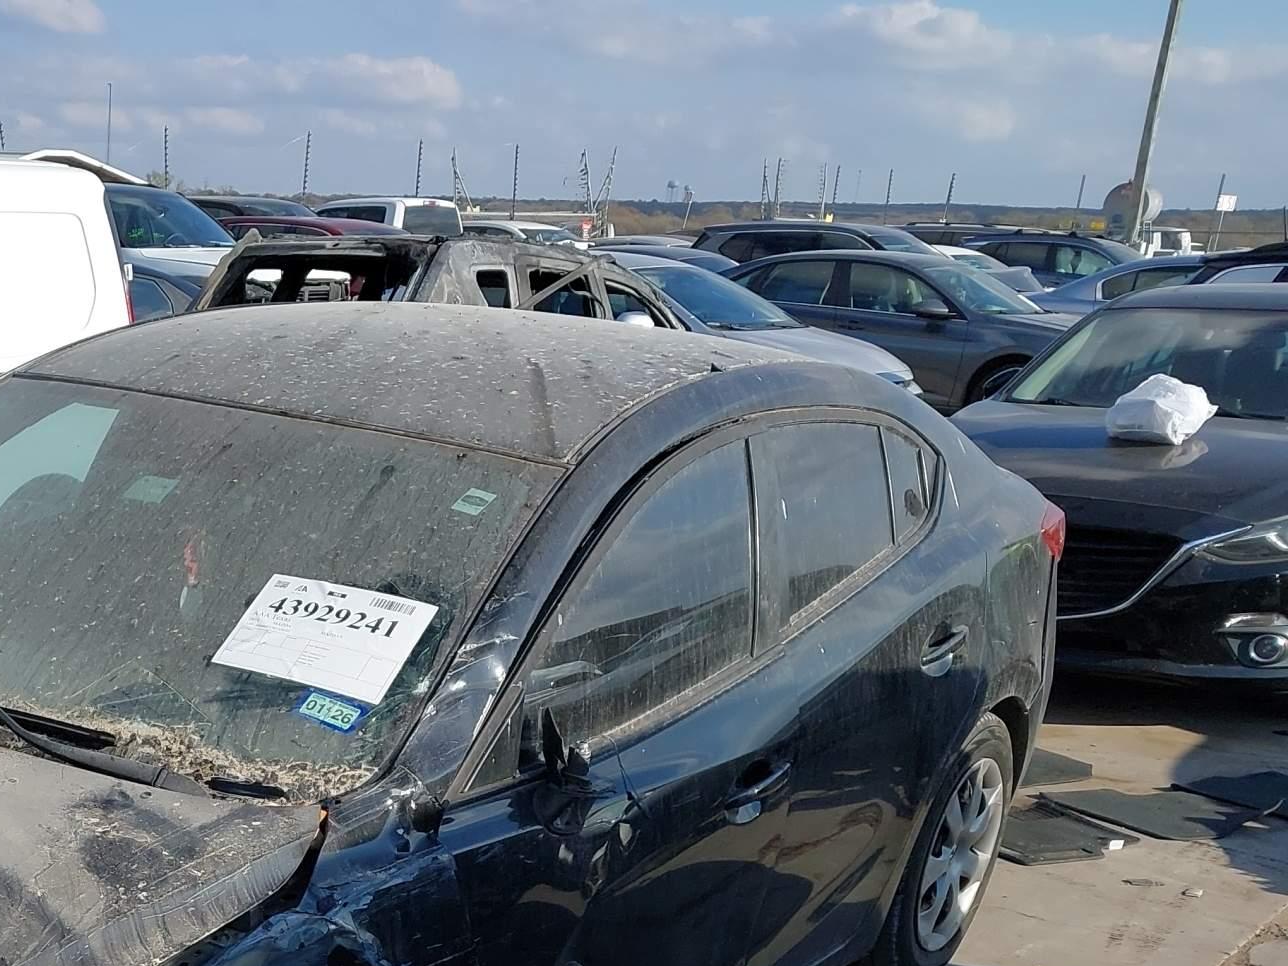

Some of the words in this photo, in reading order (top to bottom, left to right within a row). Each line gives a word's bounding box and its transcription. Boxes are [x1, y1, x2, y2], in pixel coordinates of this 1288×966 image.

[268, 597, 400, 639] 43929241
[305, 699, 327, 715] 01
[330, 708, 354, 724] 26
